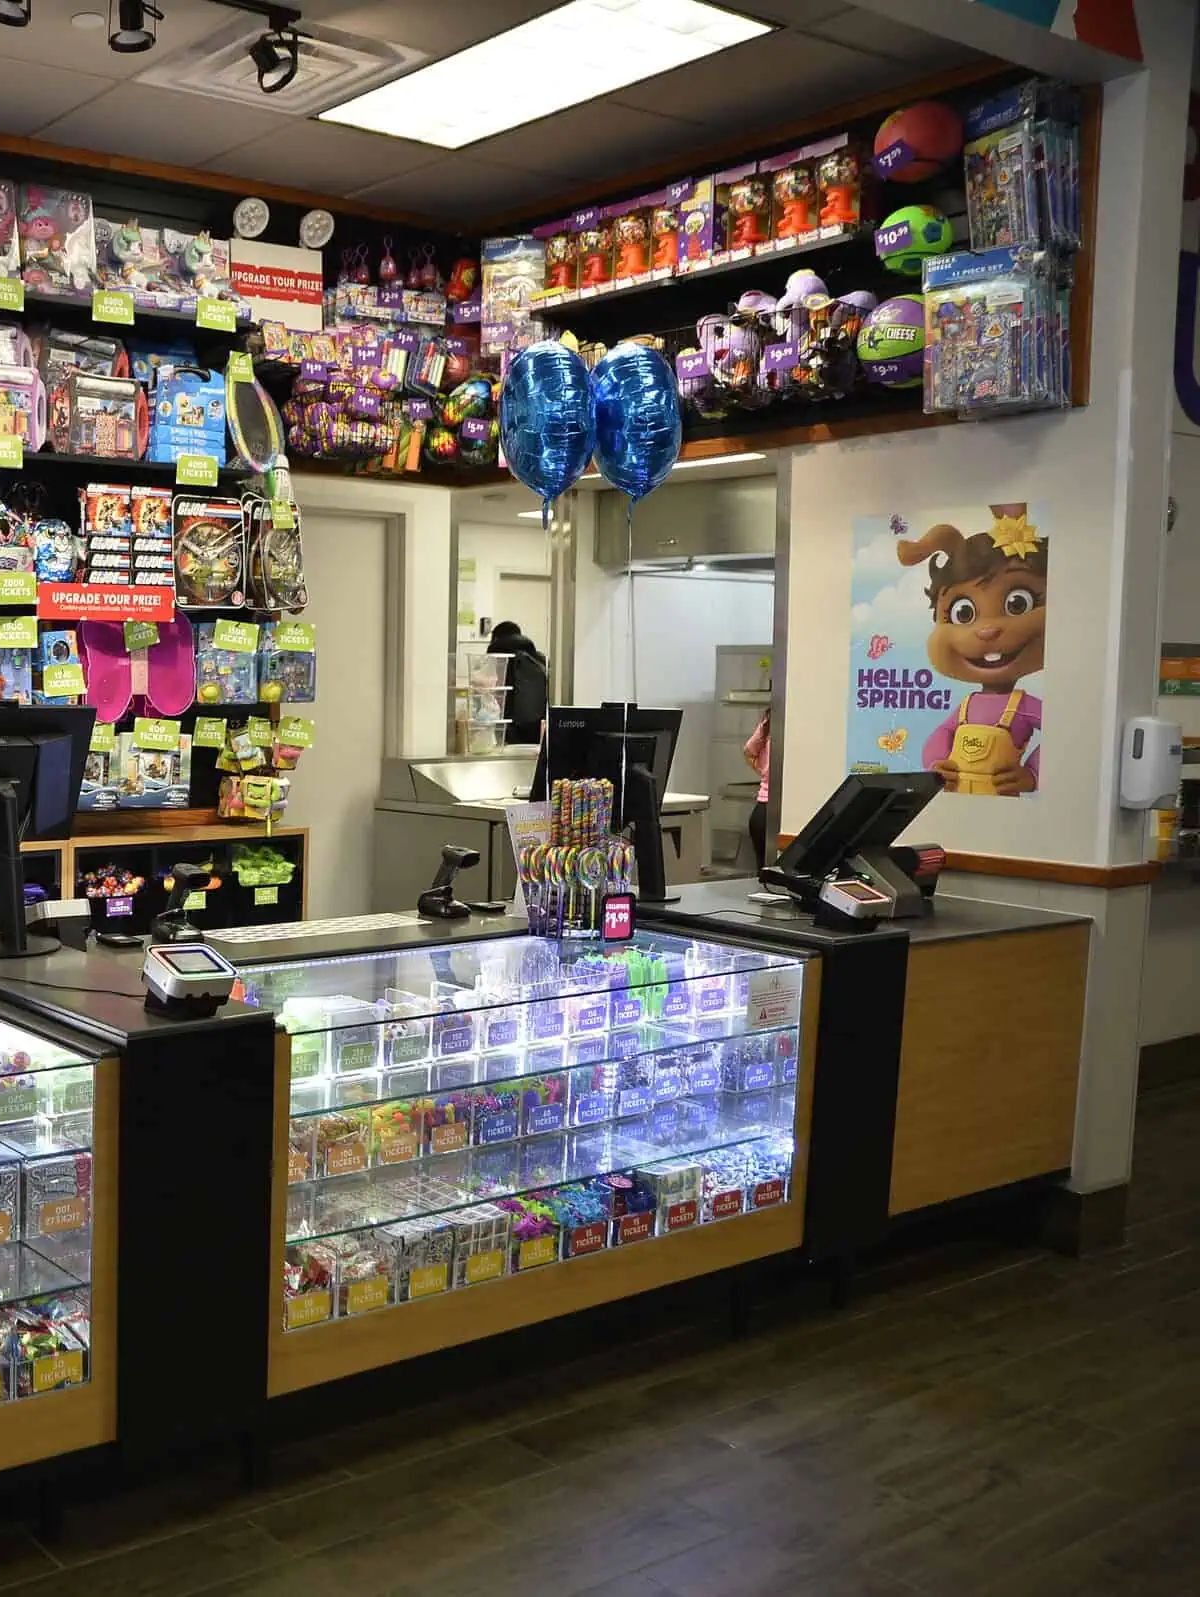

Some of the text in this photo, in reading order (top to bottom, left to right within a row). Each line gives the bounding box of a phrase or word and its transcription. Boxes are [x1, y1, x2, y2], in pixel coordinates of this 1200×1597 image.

[878, 227, 909, 247] $10.99
[232, 270, 271, 286] UPGRADE
[273, 276, 296, 288] YOUR
[297, 279, 323, 292] PRIZE!
[887, 328, 917, 340] CHEESE
[52, 593, 161, 606] UPGRADE YOUR PRIZE!
[857, 668, 933, 689] HELLO
[856, 688, 952, 711] SPRING!
[605, 910, 630, 928] $1.99
[444, 1037, 470, 1049] TICKETS
[437, 1134, 463, 1147] TICKETS
[332, 1156, 360, 1168] TICKETS
[576, 1235, 601, 1248] TICKETS
